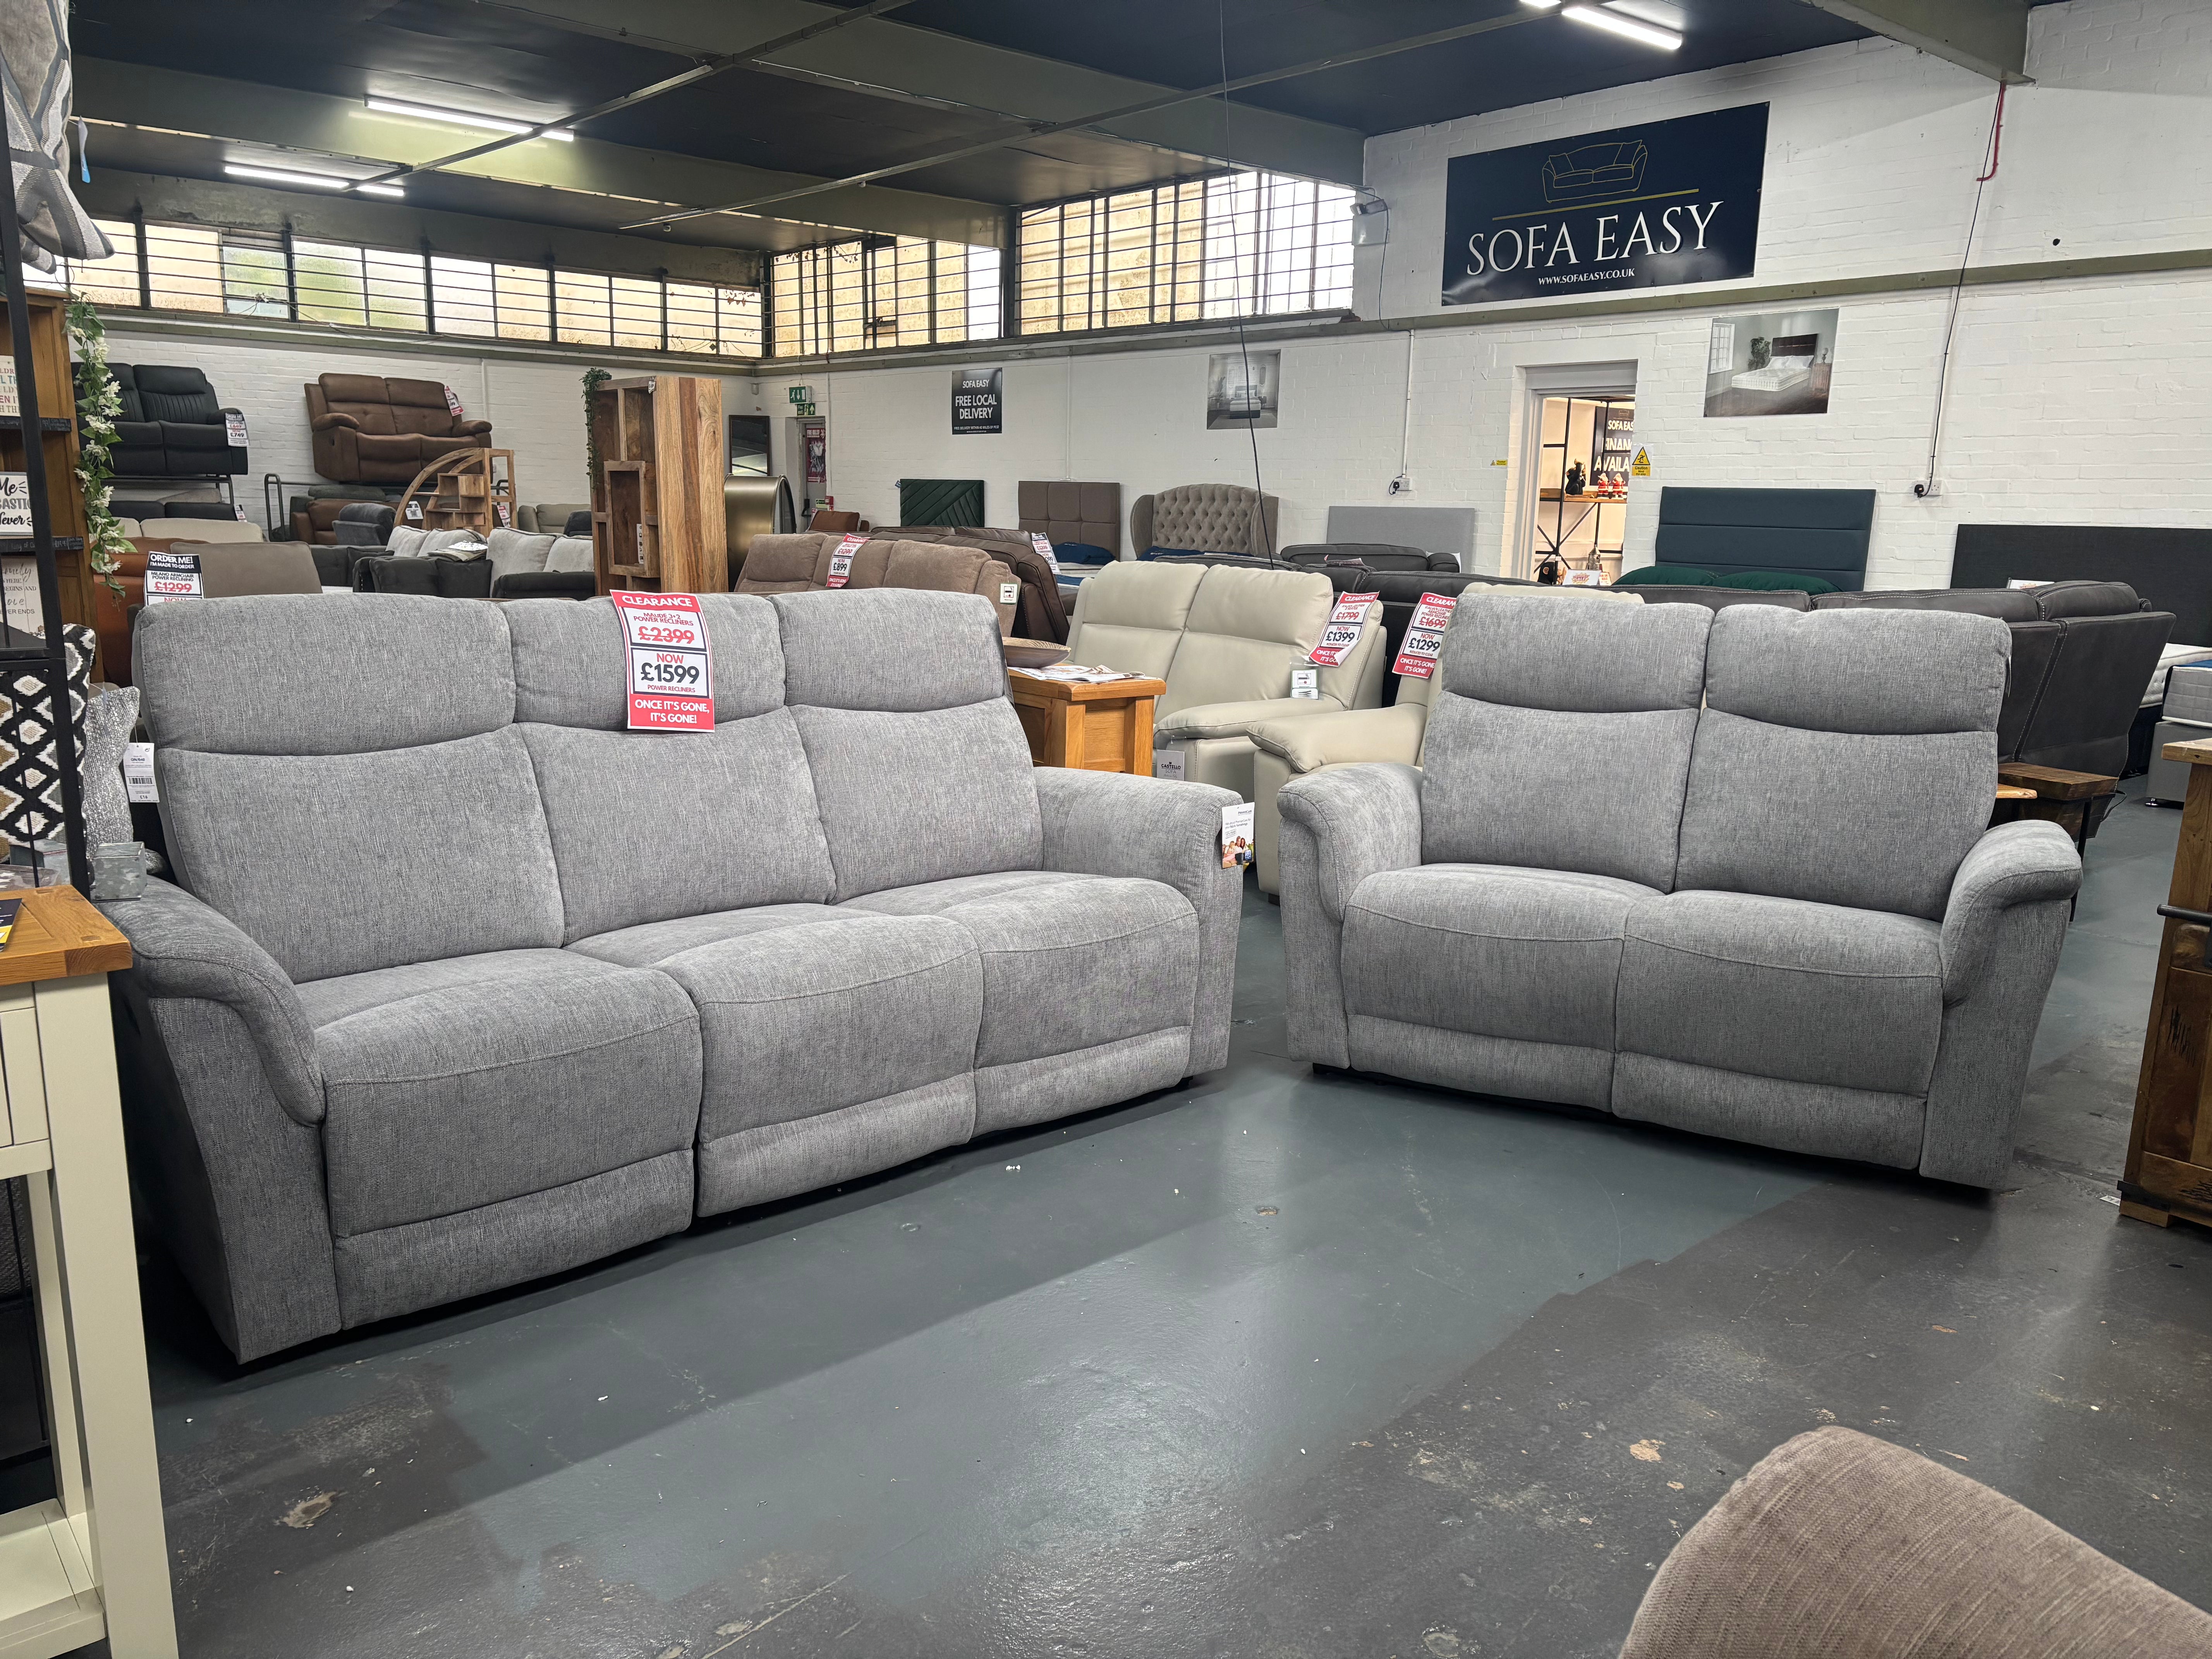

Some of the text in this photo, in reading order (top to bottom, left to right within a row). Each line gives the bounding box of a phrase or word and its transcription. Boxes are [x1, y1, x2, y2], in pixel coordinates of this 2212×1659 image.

[1467, 201, 1724, 275] SOFA EASY
[1538, 268, 1635, 285] WWW.SOFAEASY.CO.UK
[962, 380, 975, 388] SOFA
[955, 394, 997, 407] FREE LOCAL
[960, 407, 993, 419] DELIVERY
[1608, 420, 1623, 430] SOFA
[1602, 437, 1632, 453] INAN
[0, 498, 31, 510] ASTI
[150, 554, 177, 563] ORDER
[833, 563, 847, 571] £899
[154, 581, 192, 592] £1299
[622, 595, 693, 607] CLEARANCE
[1336, 612, 1360, 620] £1799
[1419, 617, 1446, 628] £1699
[638, 626, 694, 644] £2399
[1326, 631, 1355, 642] £1399
[1408, 637, 1440, 651] £1299
[657, 653, 684, 663] NOW
[641, 662, 699, 684] £1599
[635, 699, 709, 714] ONCE IT'S GONE,
[650, 713, 697, 724] IT'S GONE!
